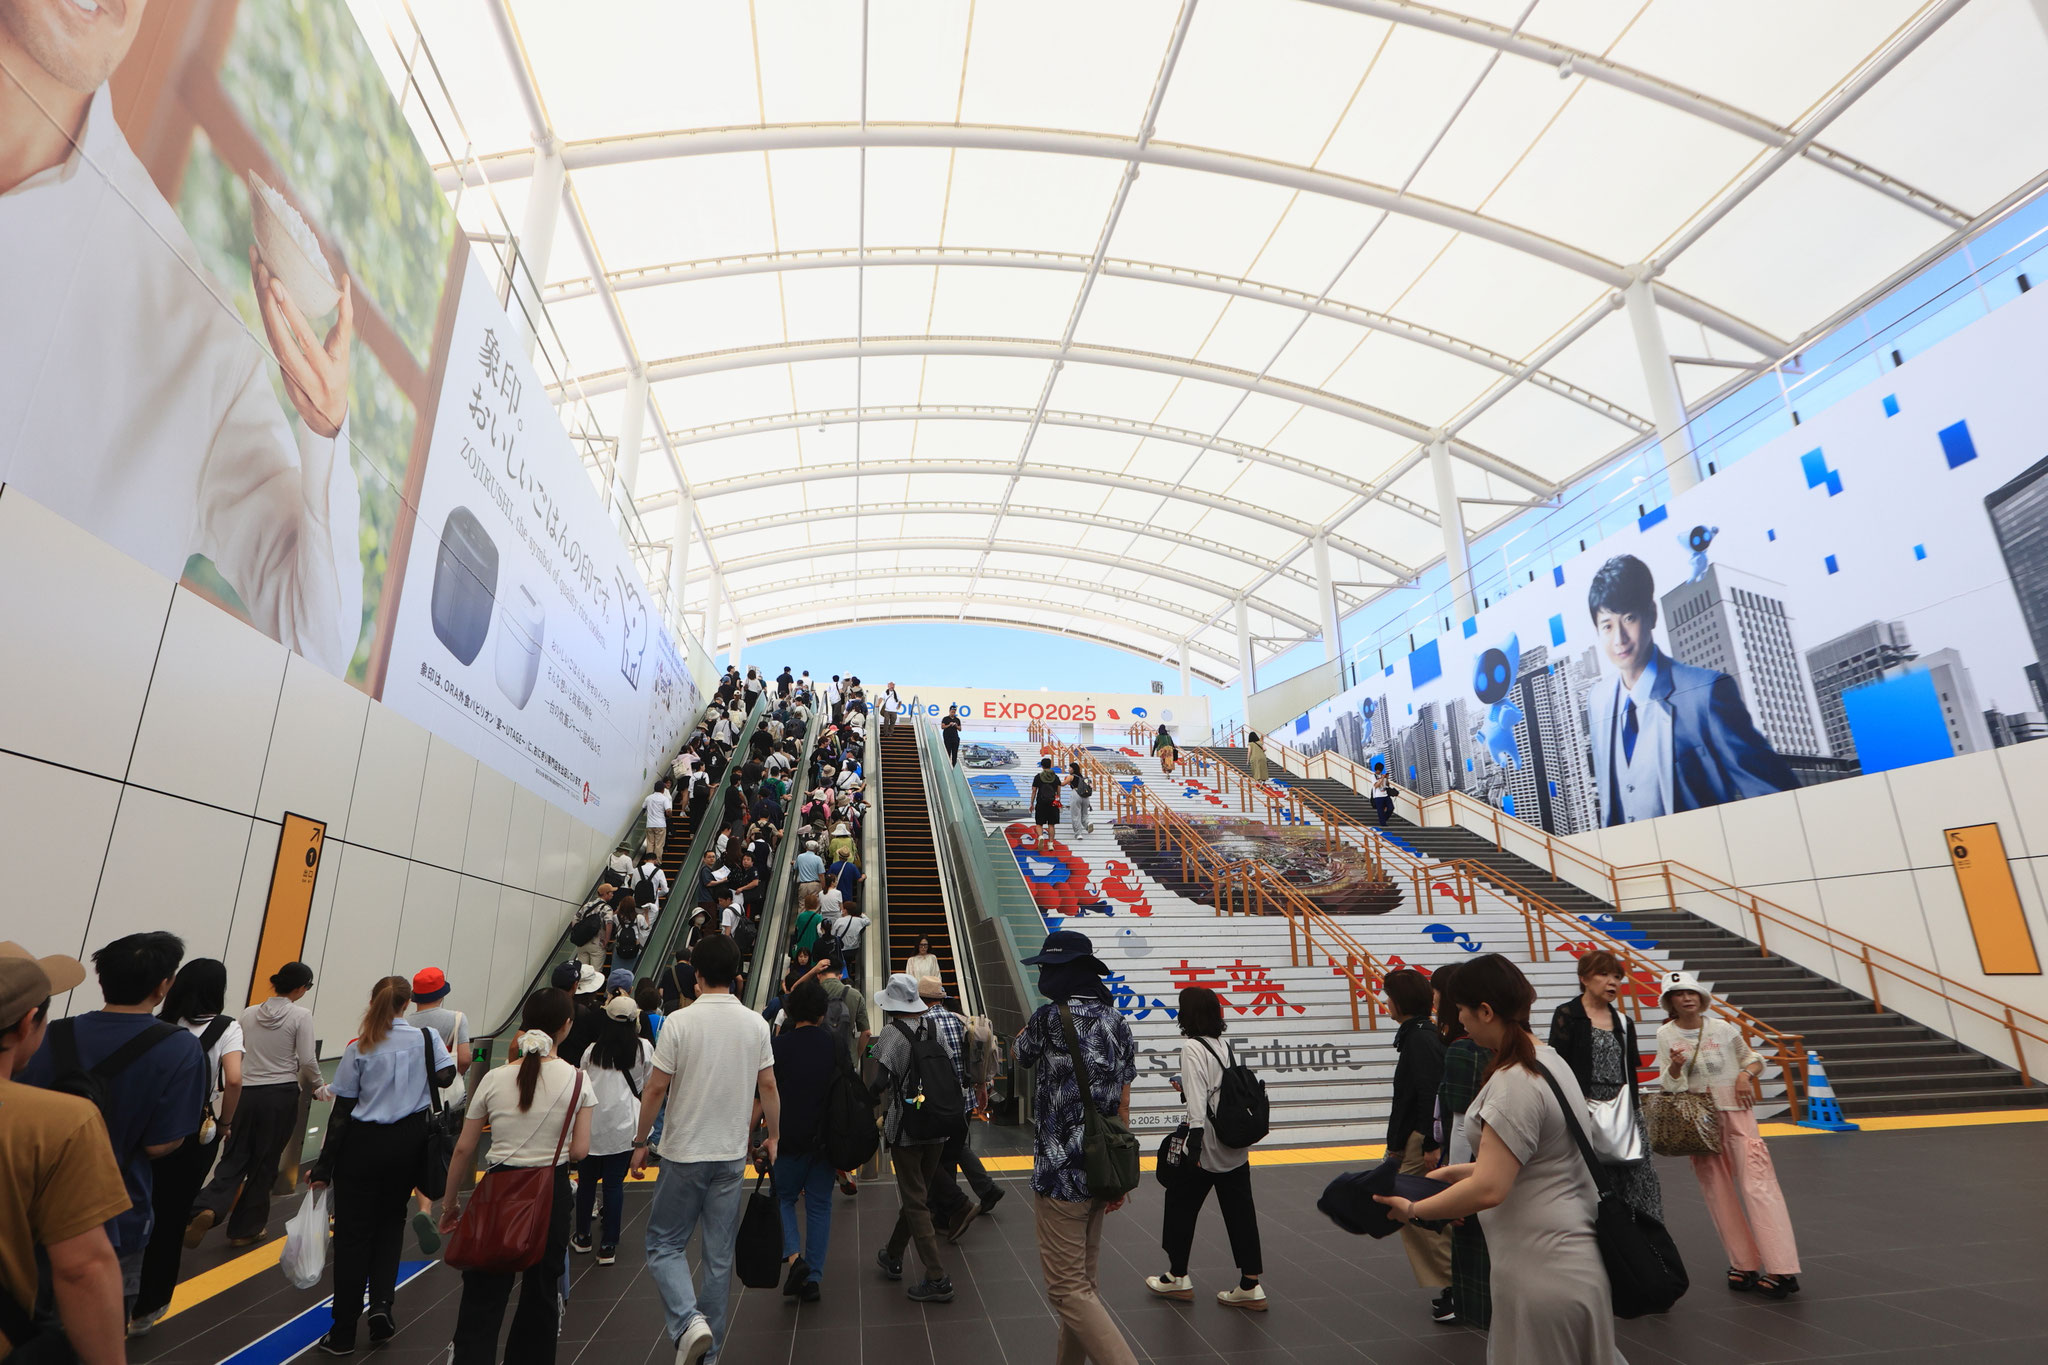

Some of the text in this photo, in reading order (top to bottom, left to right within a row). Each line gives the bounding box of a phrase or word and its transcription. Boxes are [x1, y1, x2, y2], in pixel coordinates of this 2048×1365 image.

[478, 327, 523, 432] 象印。
[468, 382, 611, 625] おいしいごはんの印です。
[460, 436, 514, 526] ZOJIRUSHI,
[515, 516, 528, 541] the
[528, 536, 553, 576] symbol
[552, 567, 561, 586] of
[559, 578, 578, 611] quality
[983, 701, 1097, 722] EXPO2025
[1671, 973, 1680, 982] C
[1229, 1038, 1363, 1073] Future
[1138, 1116, 1160, 1125] 2025
